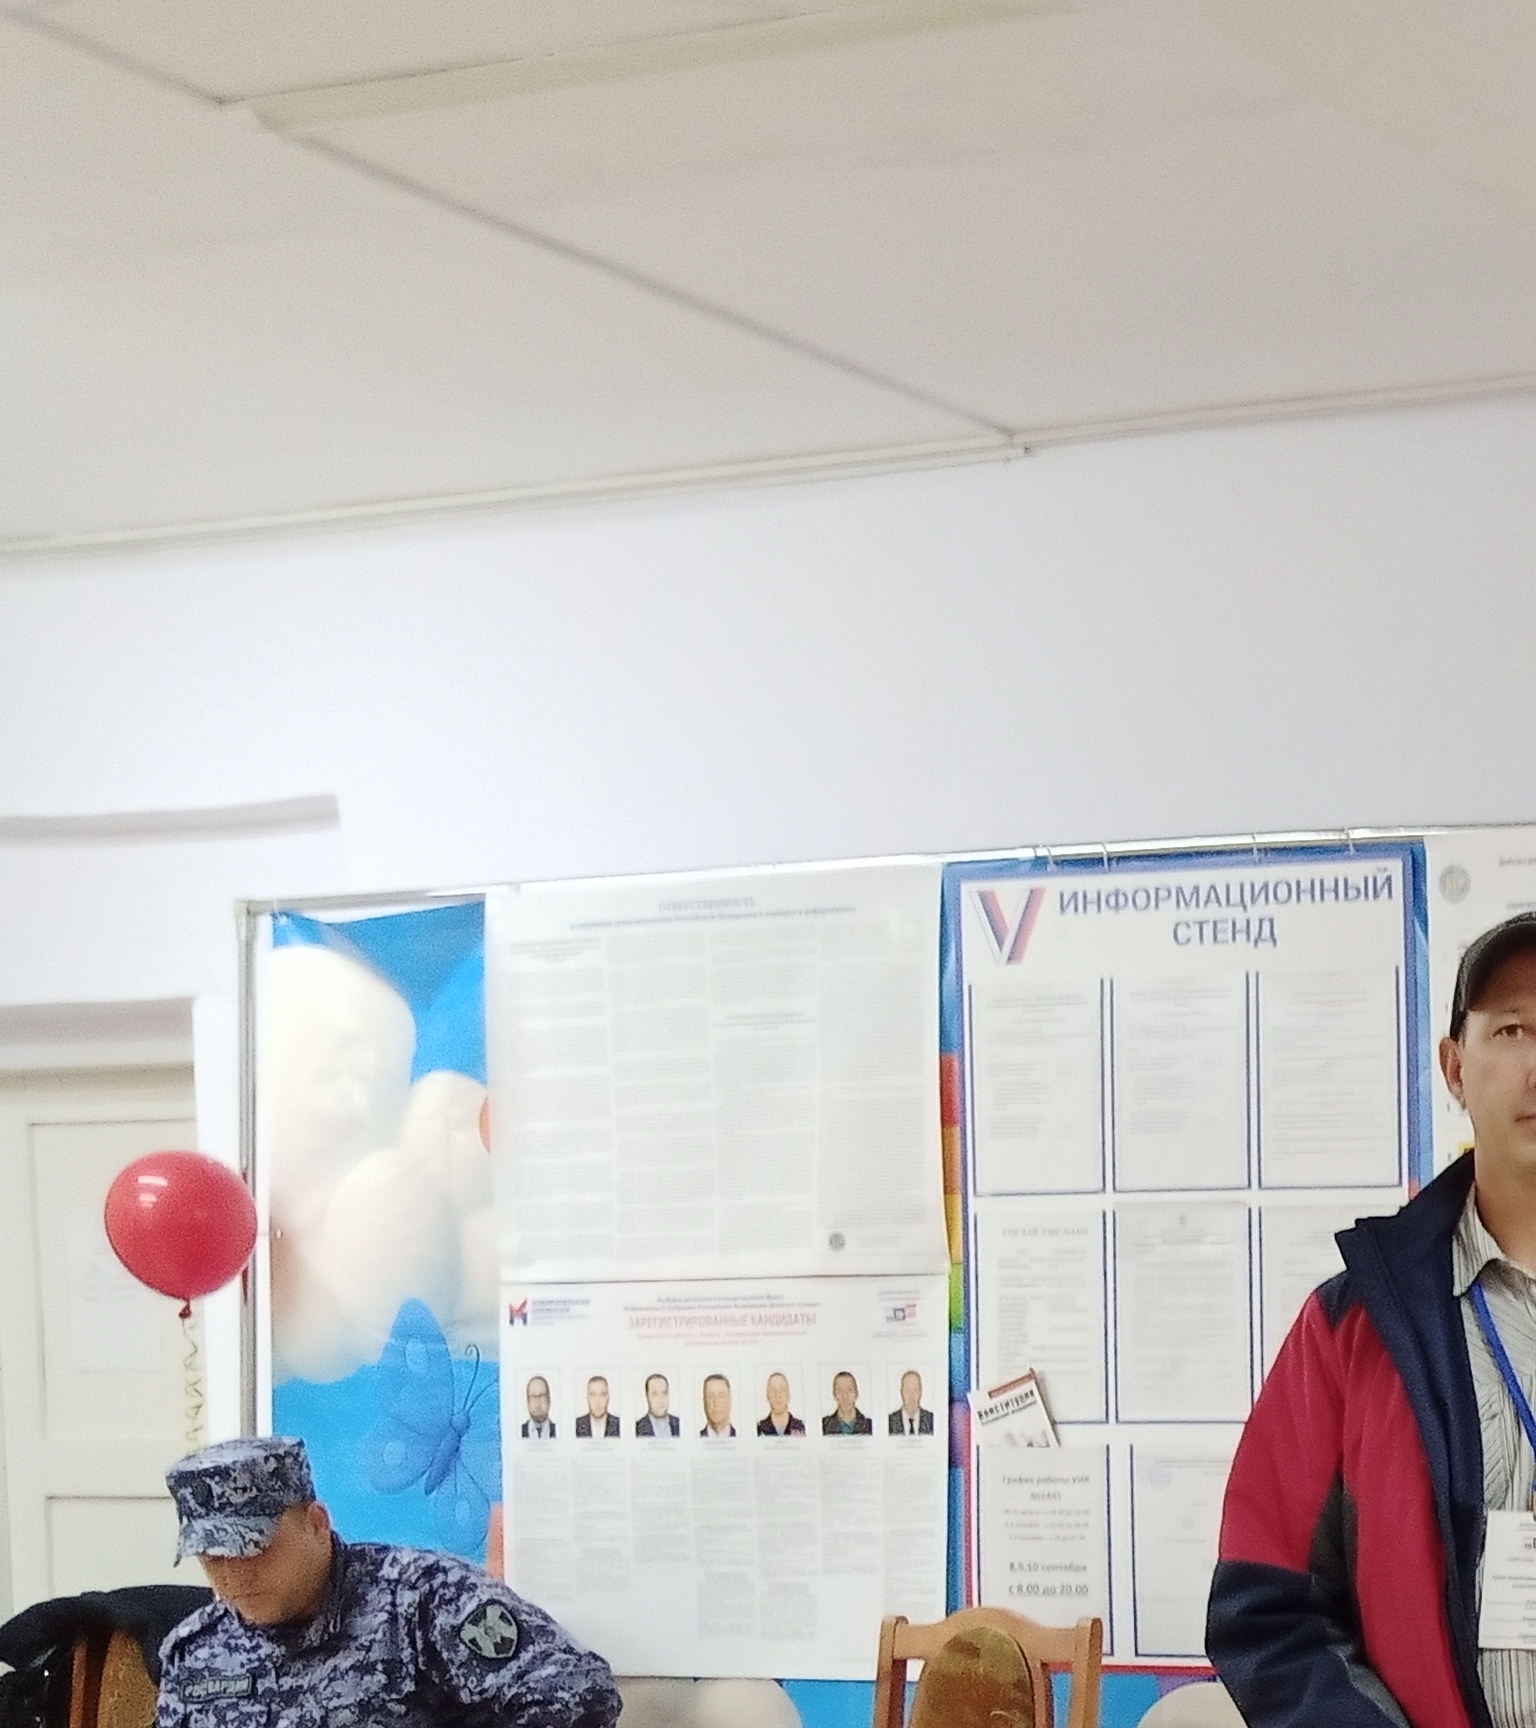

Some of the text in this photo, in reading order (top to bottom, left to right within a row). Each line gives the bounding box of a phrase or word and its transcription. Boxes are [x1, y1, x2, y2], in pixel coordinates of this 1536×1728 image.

[1058, 867, 1394, 916] ИНФОРМАЦИОННЫЙ
[1172, 916, 1278, 949] СТЕНД
[627, 1312, 818, 1331] ЗАРЕГИСТРИРОВАННЫЕ КАНДИДАТЫ
[1040, 1561, 1087, 1574] сентября
[1042, 1585, 1057, 1597] до
